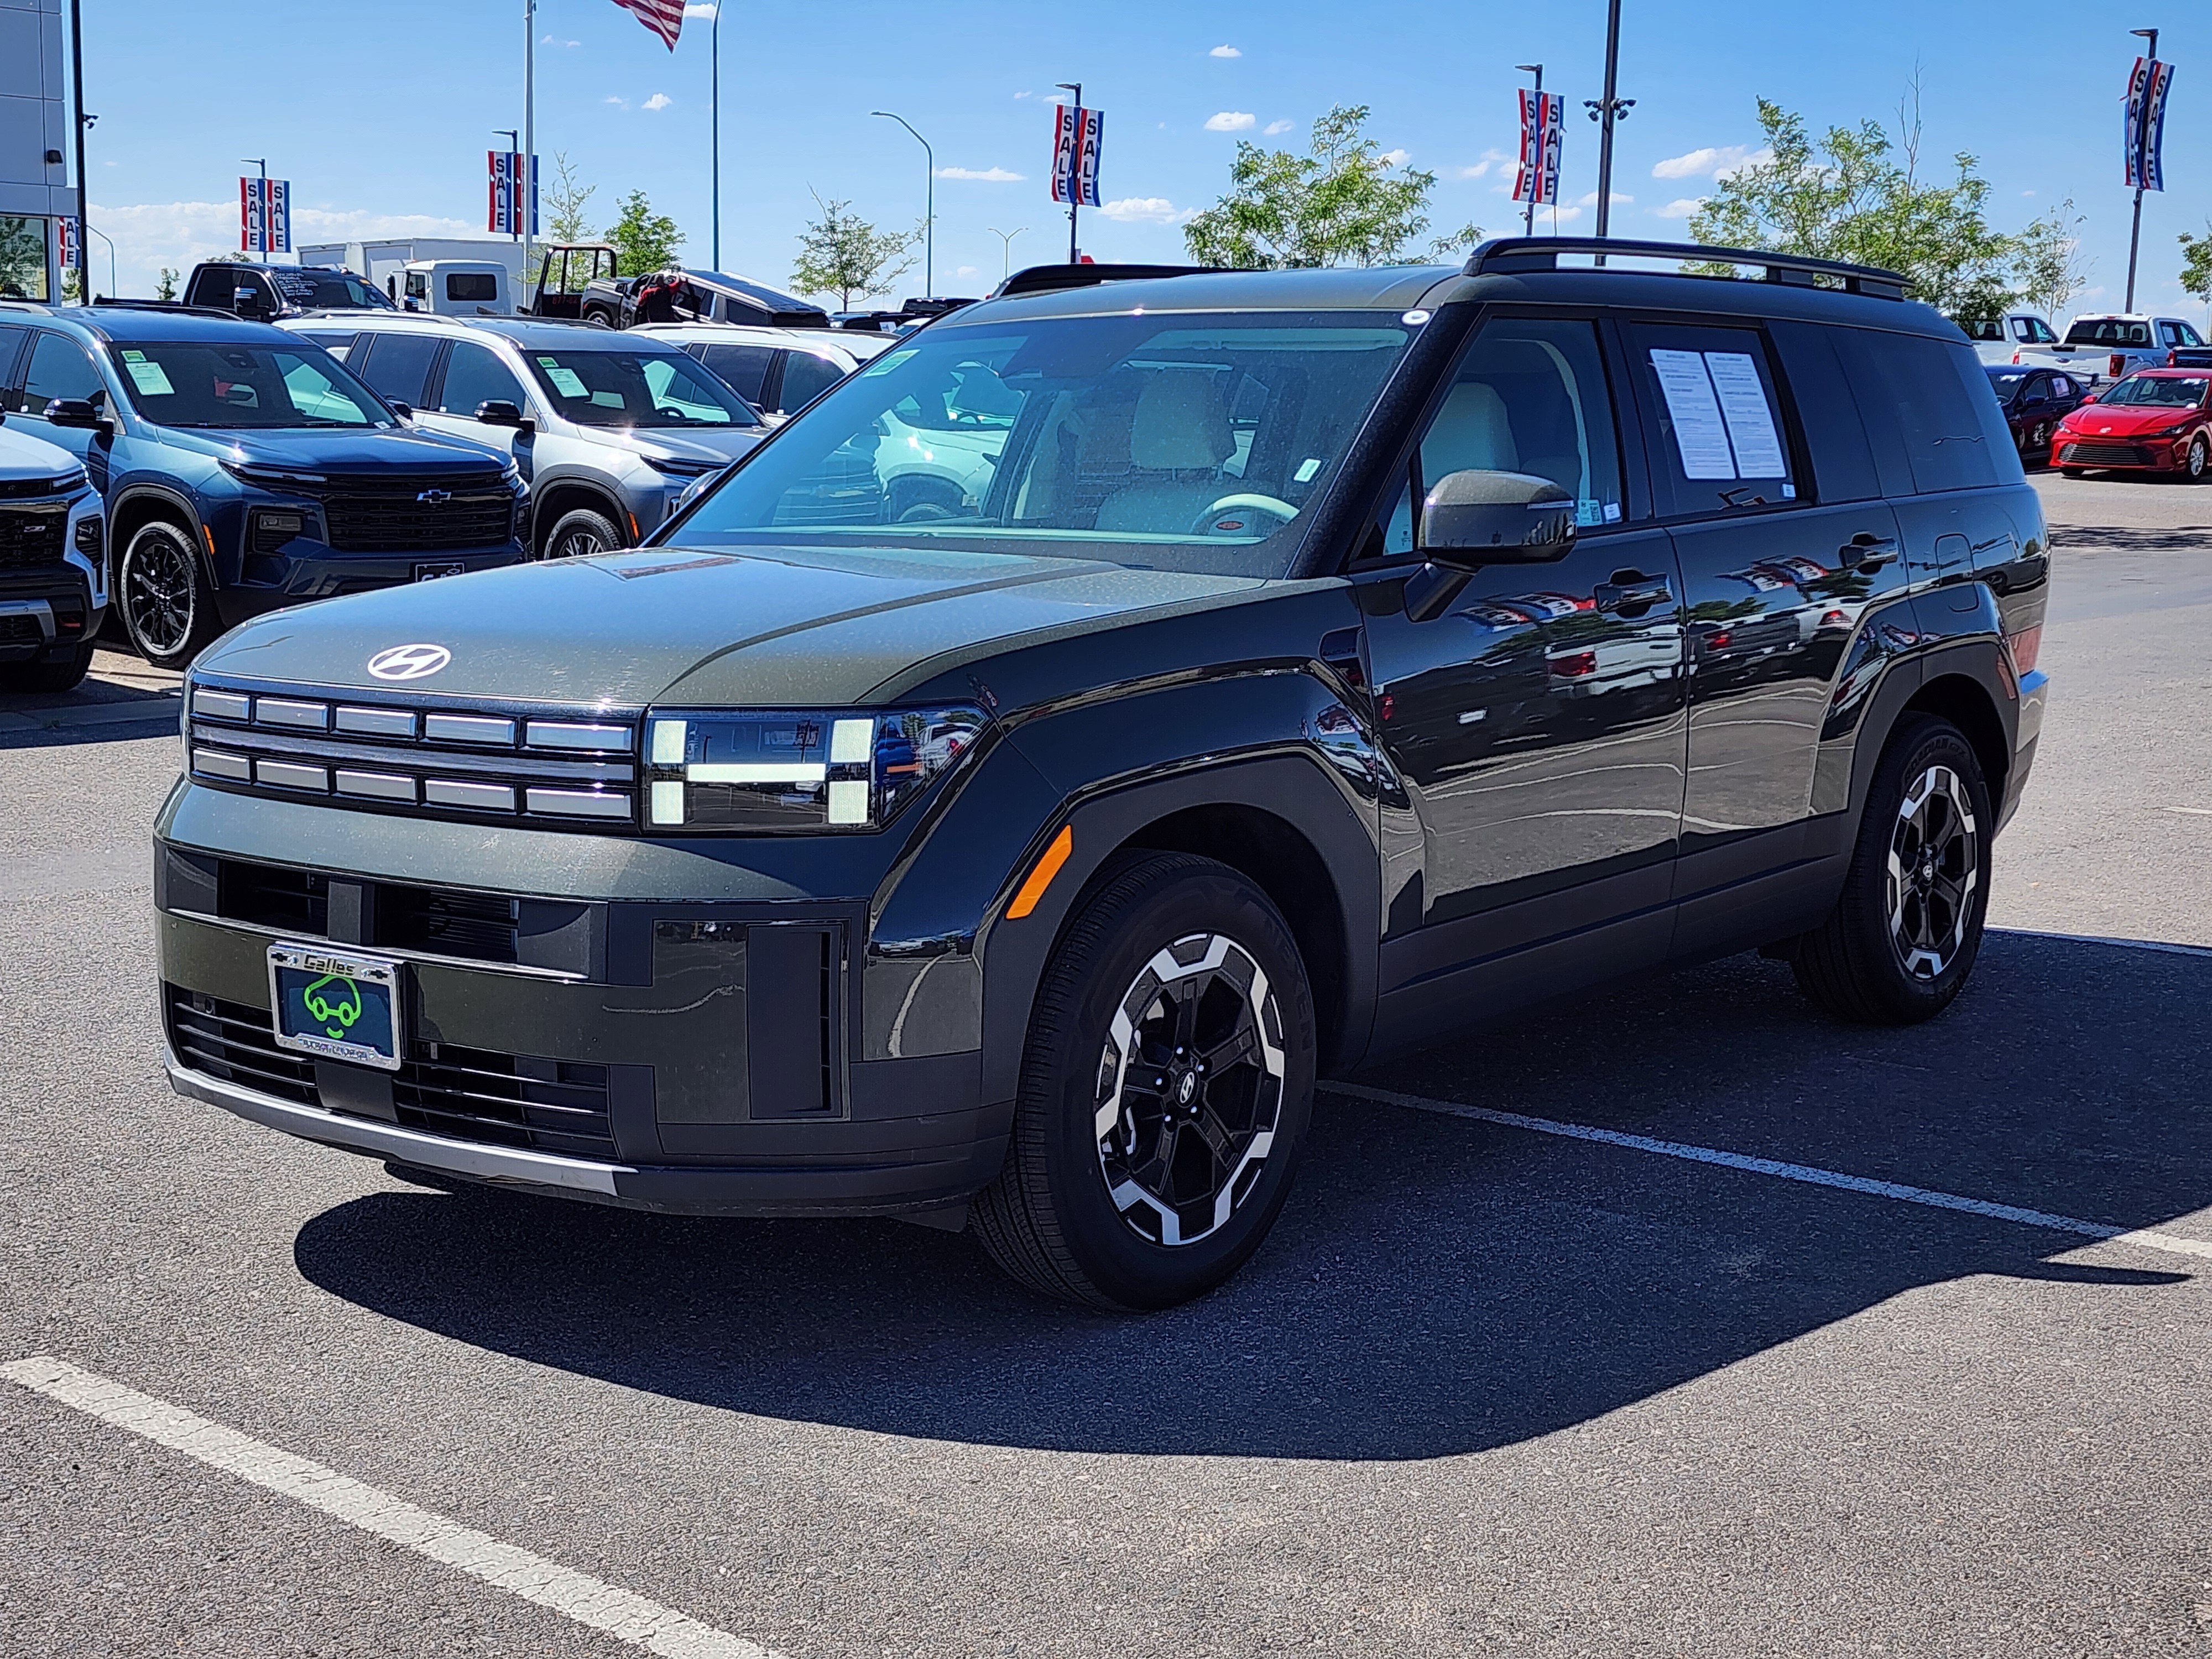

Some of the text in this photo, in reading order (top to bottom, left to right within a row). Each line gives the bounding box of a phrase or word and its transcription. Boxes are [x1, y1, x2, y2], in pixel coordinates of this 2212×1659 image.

[1057, 114, 1072, 195] SALE
[1083, 118, 1097, 199] SALE
[1522, 100, 1536, 192] SALE
[1544, 103, 1559, 196] SALE
[2147, 75, 2166, 181] SALE
[248, 184, 258, 246] SALE
[274, 186, 284, 247] SALE
[495, 158, 505, 226] SALE
[65, 221, 75, 263] ALE
[304, 954, 356, 976] Galles
